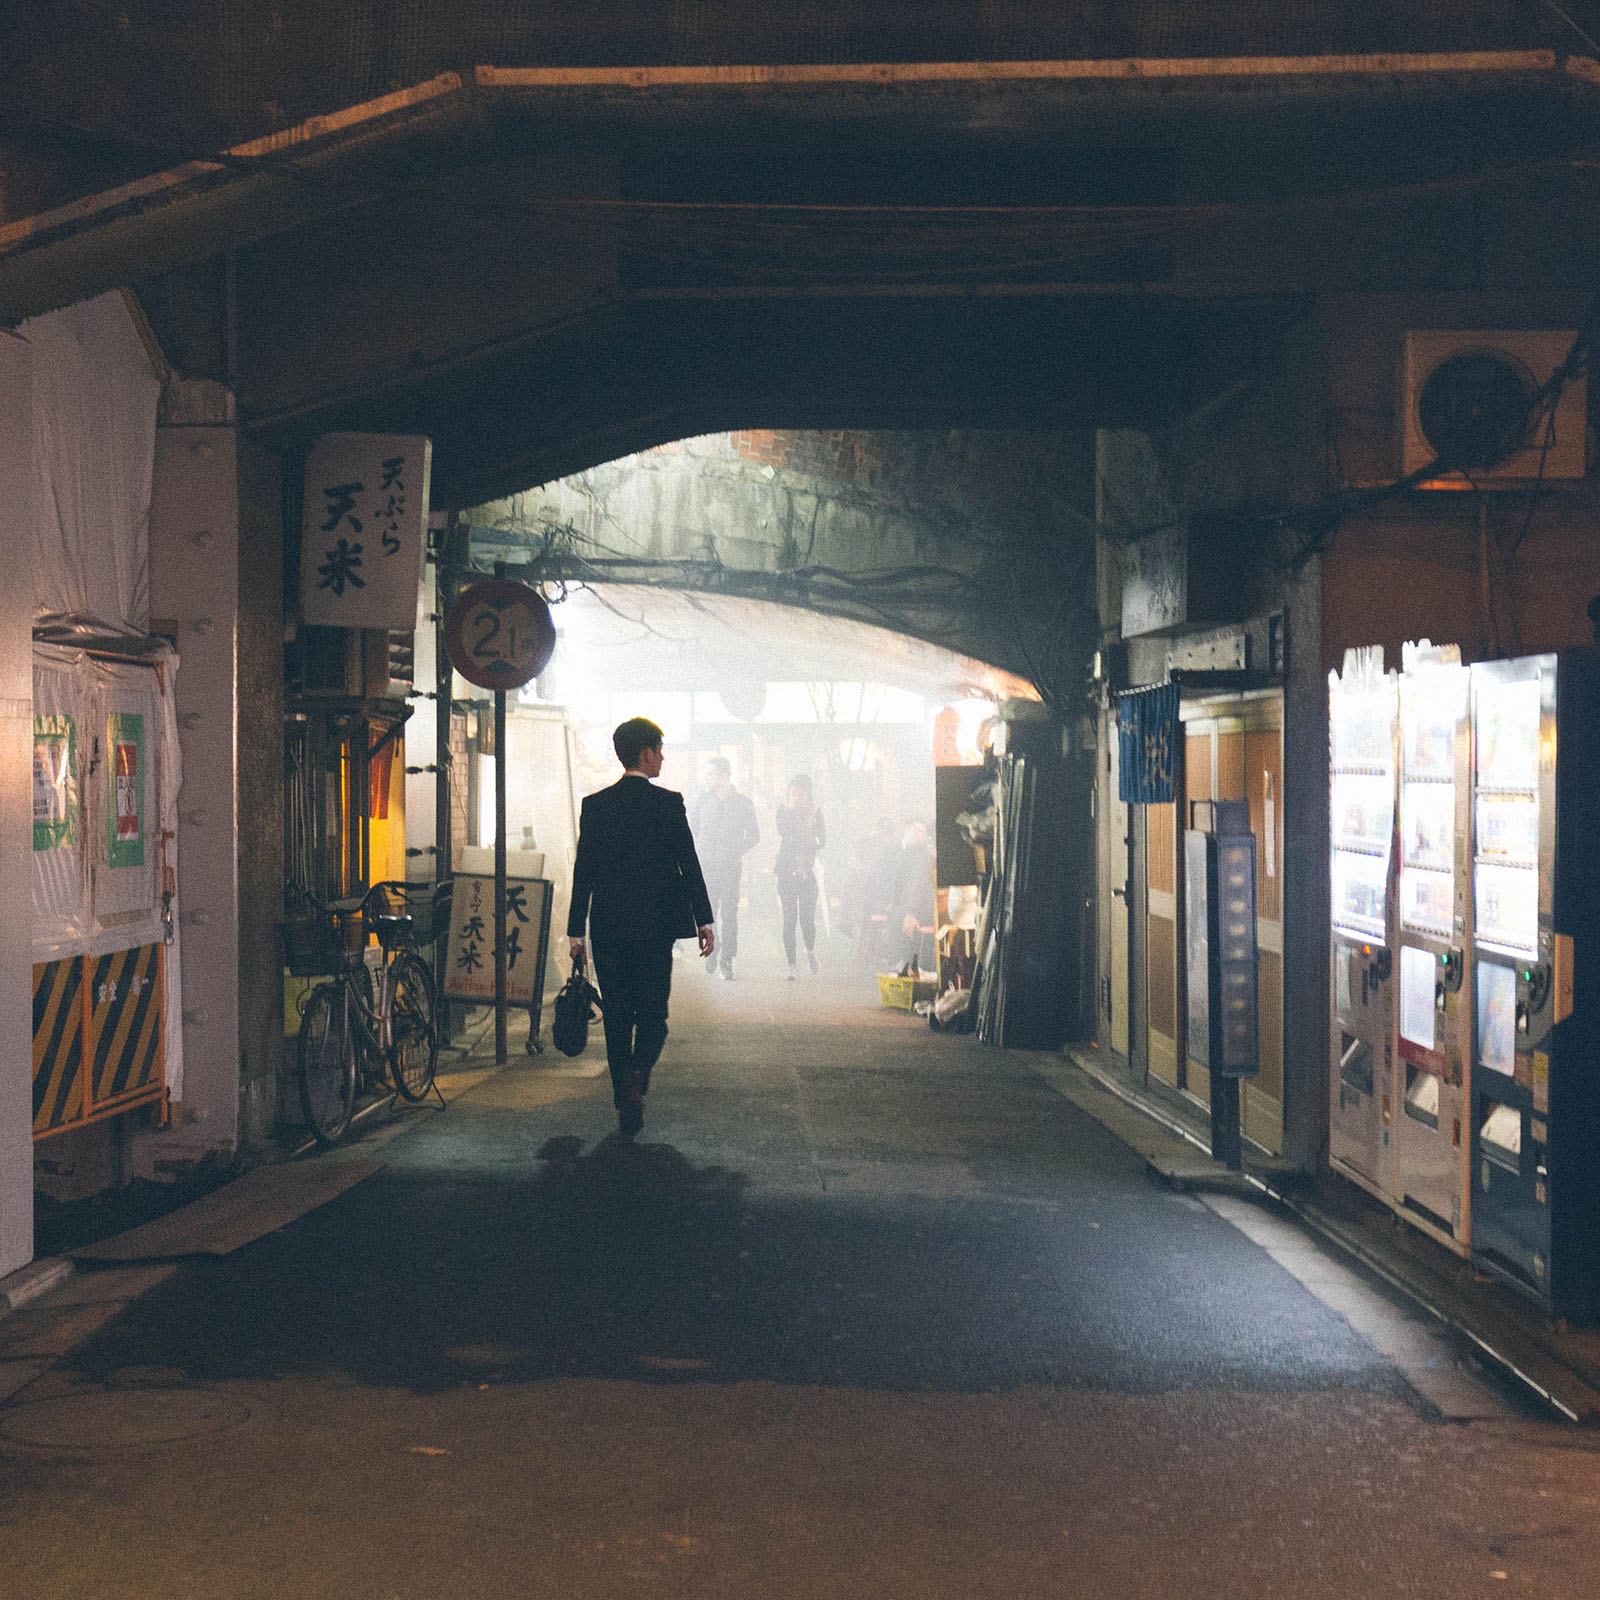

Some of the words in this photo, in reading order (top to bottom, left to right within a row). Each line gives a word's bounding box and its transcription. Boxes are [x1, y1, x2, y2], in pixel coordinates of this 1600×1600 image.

[317, 482, 366, 597] 天米
[374, 456, 405, 557] 天ぷら
[457, 916, 485, 974] 天米
